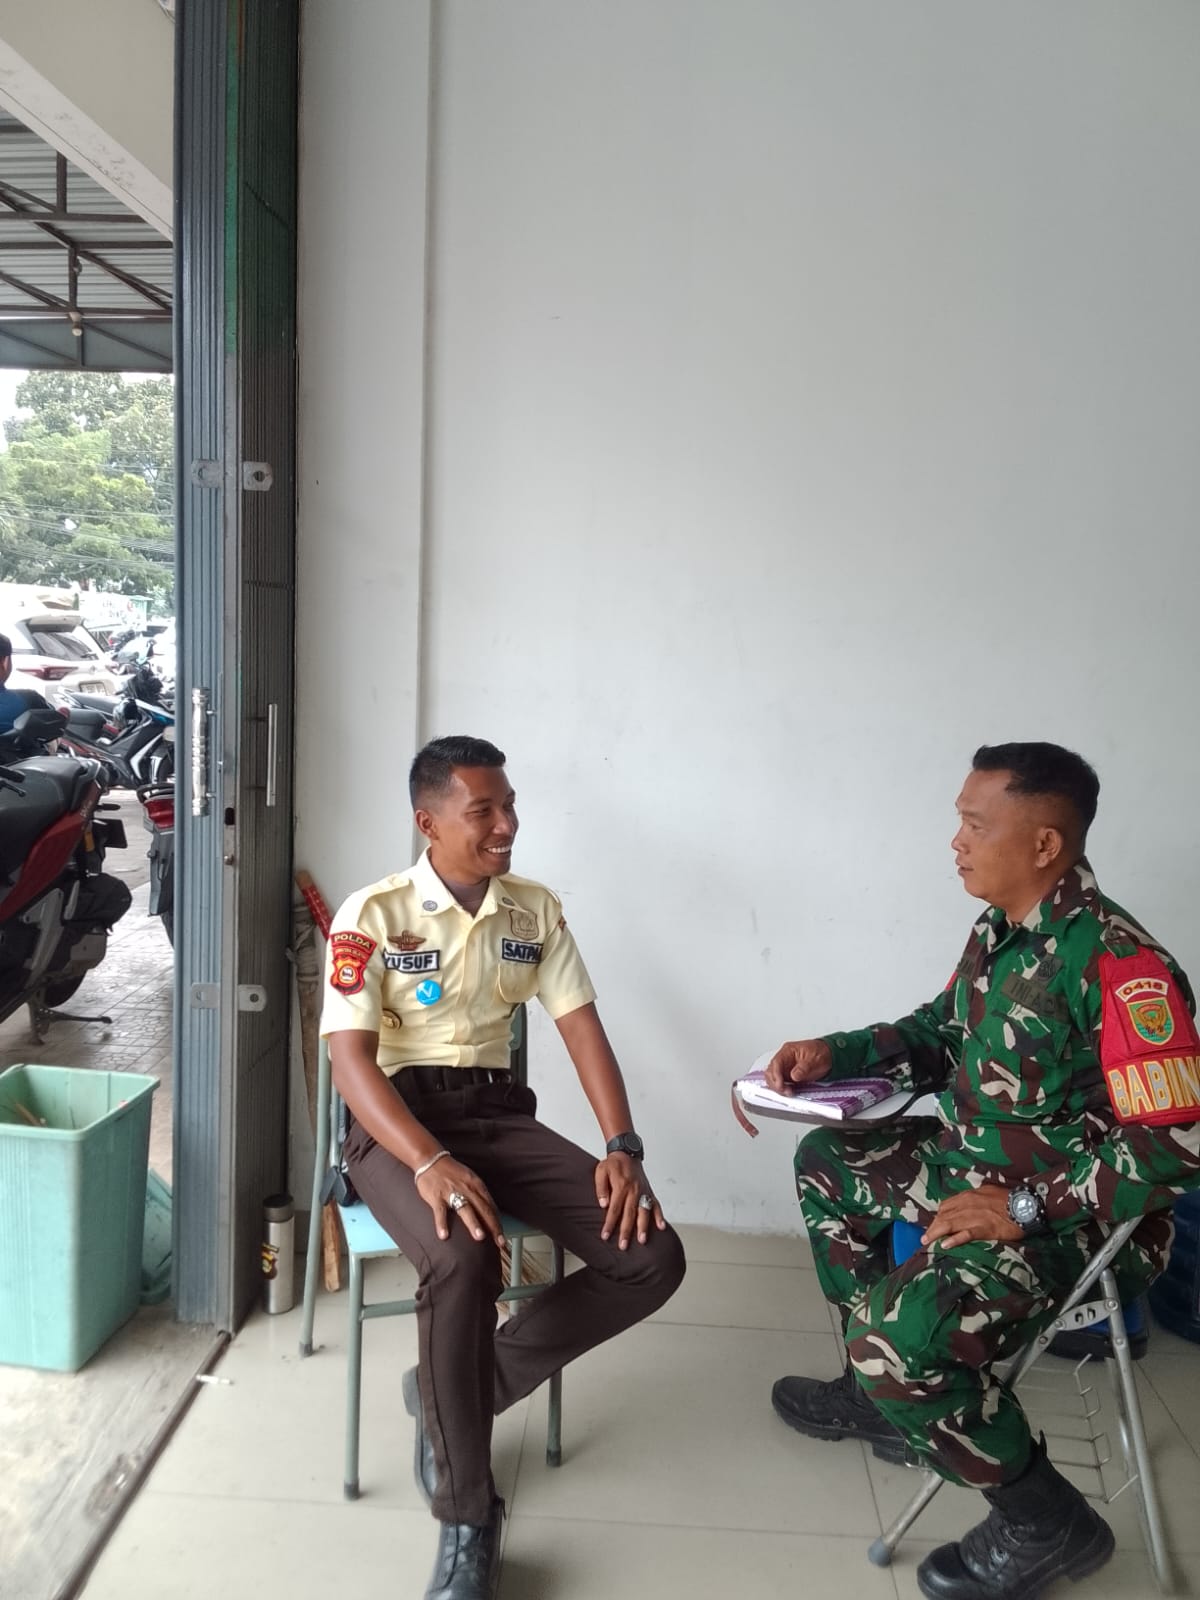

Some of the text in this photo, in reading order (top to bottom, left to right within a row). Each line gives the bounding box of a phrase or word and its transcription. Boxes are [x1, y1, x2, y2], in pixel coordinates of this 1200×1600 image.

[334, 933, 370, 949] POLDA
[384, 954, 433, 970] YUSUF
[1107, 1055, 1200, 1118] BABIN
